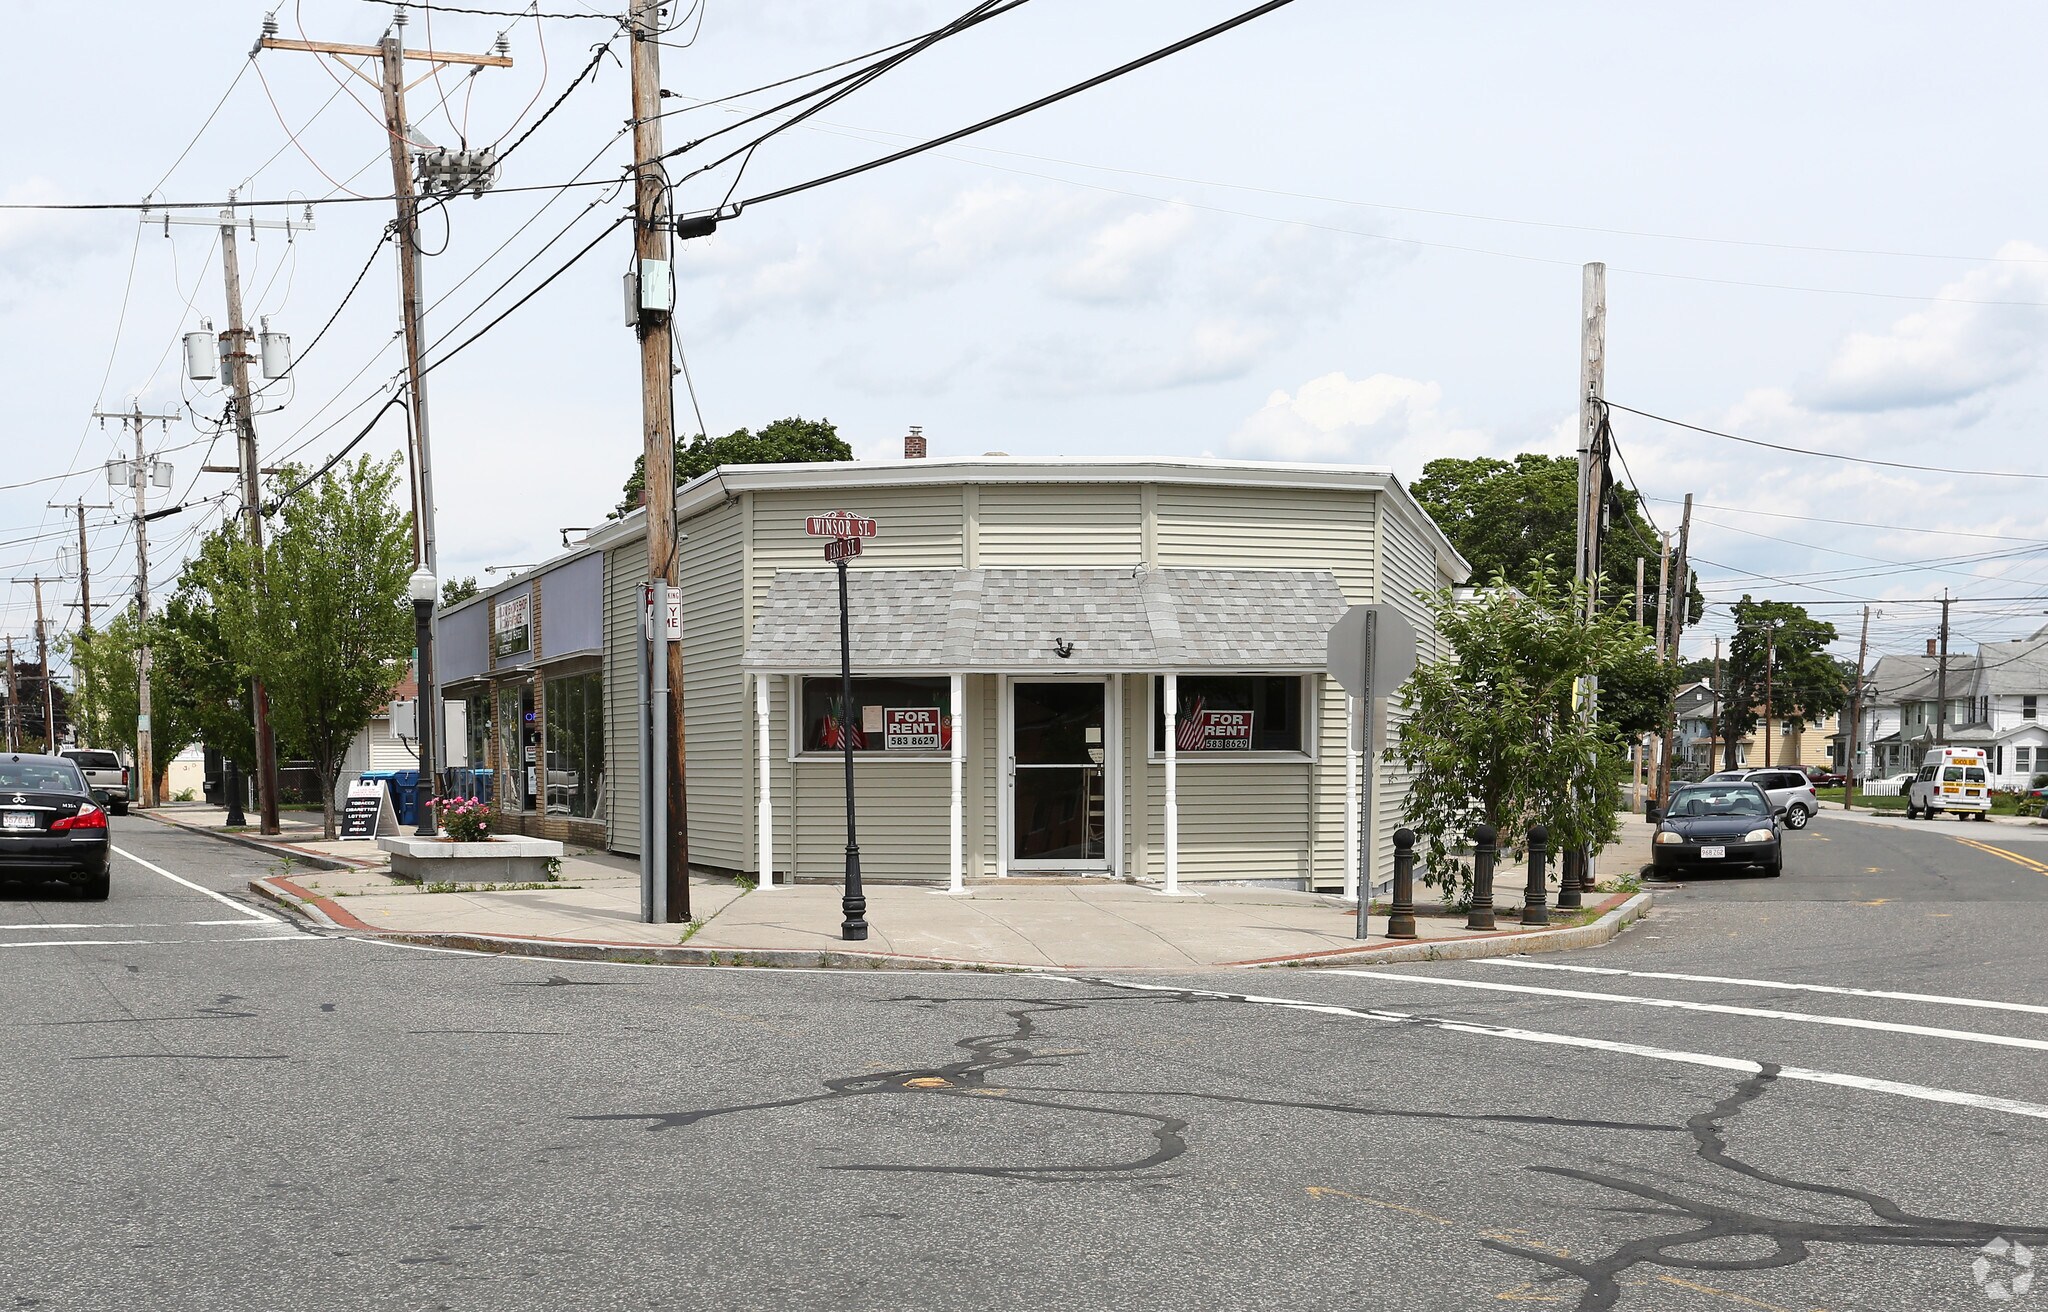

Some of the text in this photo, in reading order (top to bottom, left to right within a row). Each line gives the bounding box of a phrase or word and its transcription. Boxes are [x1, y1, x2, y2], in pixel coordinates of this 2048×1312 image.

[813, 518, 871, 536] WINSOR ST.
[829, 541, 843, 559] EAST
[894, 711, 930, 722] FOR
[1210, 714, 1244, 725] FOR
[889, 722, 936, 734] RENT
[1204, 725, 1249, 736] RENT
[891, 736, 935, 745] 583 8629
[1206, 740, 1247, 748] 583 8629
